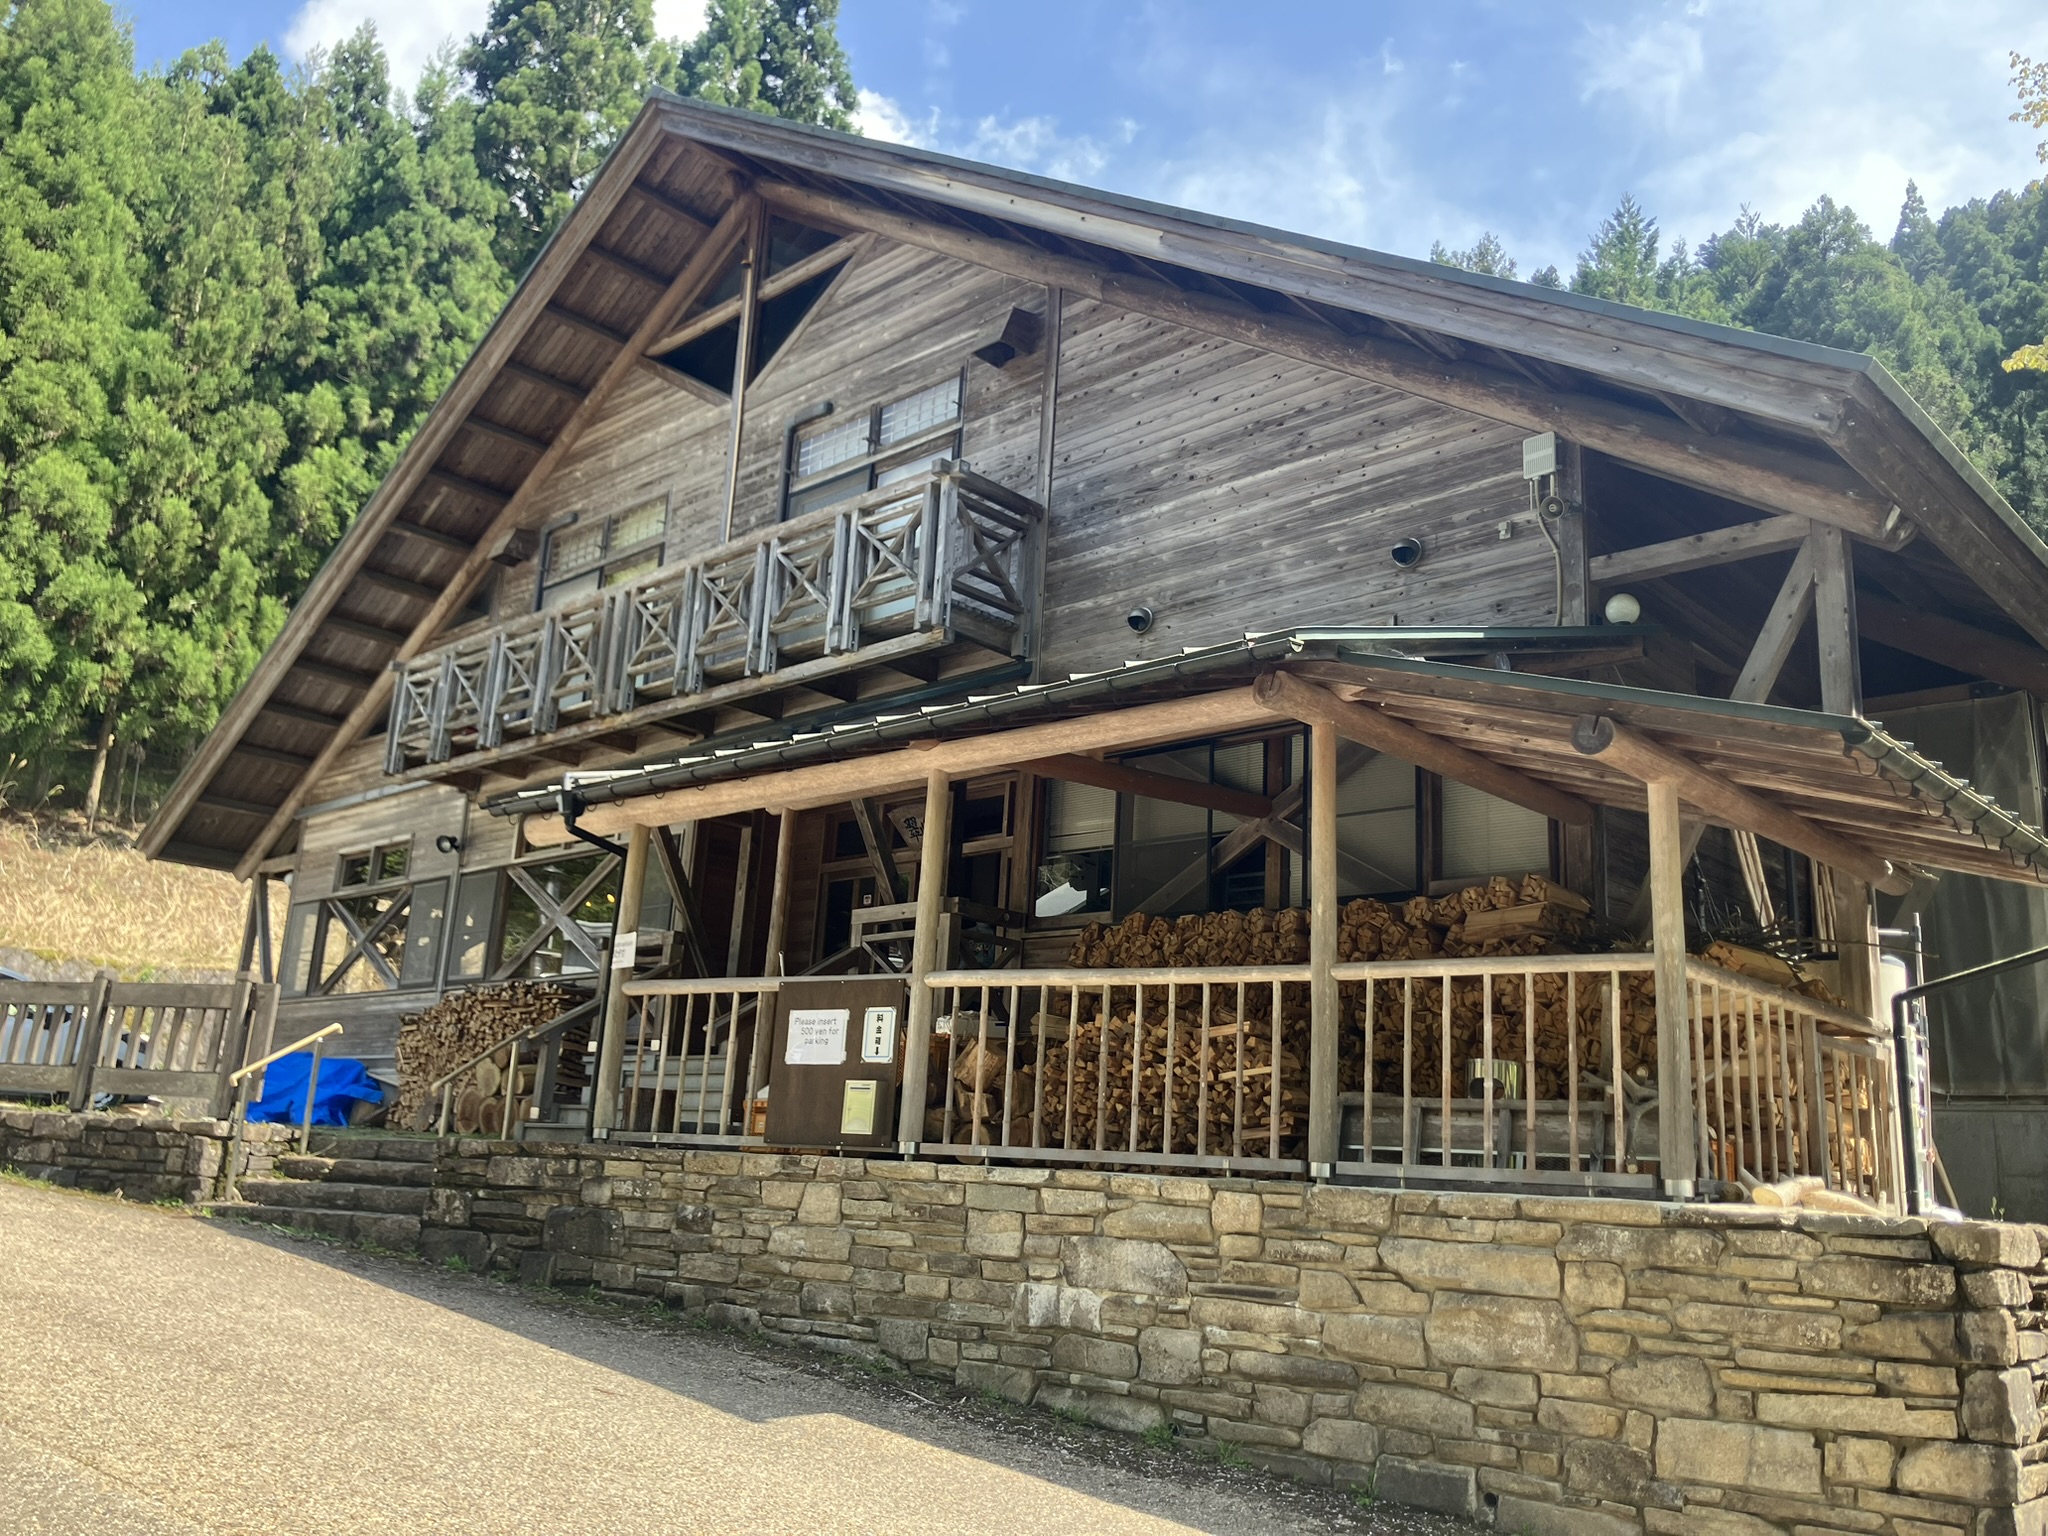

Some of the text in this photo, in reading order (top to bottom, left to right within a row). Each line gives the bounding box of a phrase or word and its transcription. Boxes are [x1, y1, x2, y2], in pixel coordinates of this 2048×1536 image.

[794, 1017, 837, 1026] Please insert
[801, 1027, 839, 1036] 500 yen for
[804, 1036, 829, 1046] parking
